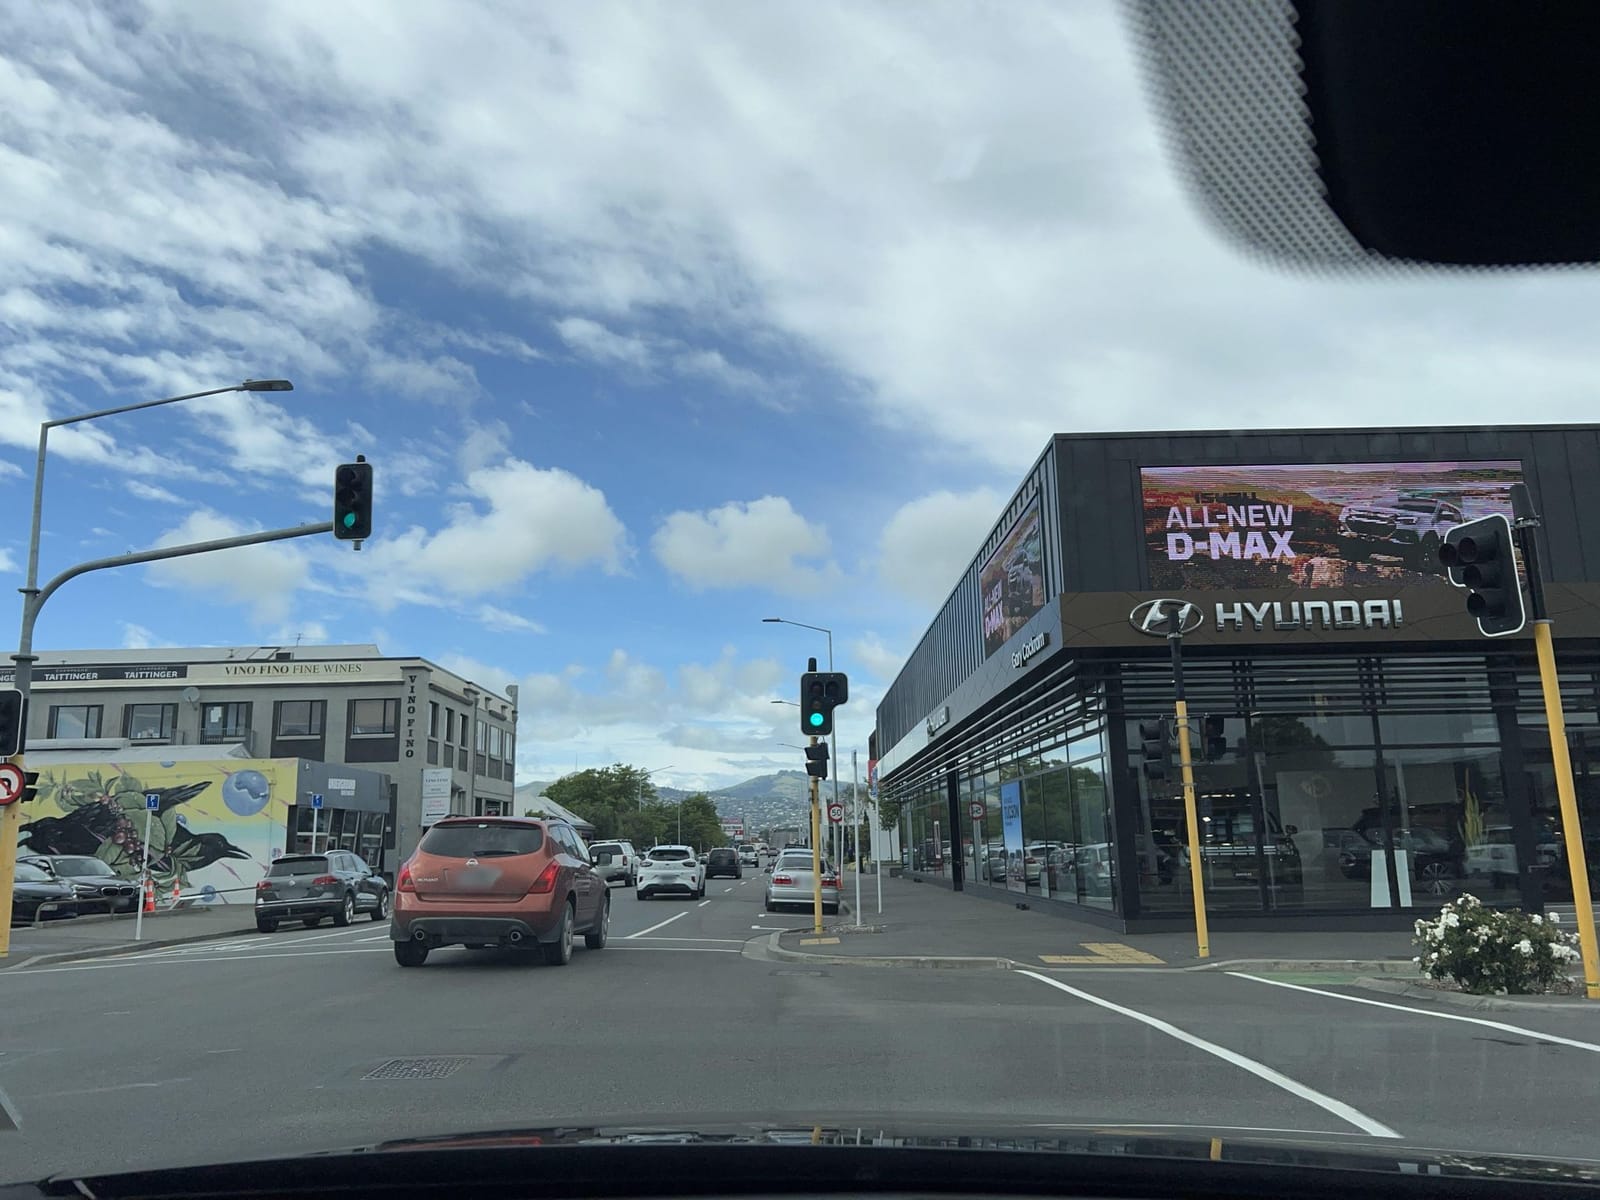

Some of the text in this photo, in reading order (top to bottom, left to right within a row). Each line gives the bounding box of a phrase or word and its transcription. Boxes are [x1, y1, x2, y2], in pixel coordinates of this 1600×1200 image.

[1166, 504, 1293, 528] ALL-NEW
[1166, 531, 1297, 561] D-MAX
[1215, 600, 1403, 632] HYUNDAI
[1011, 632, 1045, 669] Gary Cockram
[44, 672, 98, 681] TAITTINGER
[124, 671, 177, 679] TAITTINGER
[225, 663, 362, 675] VINO FINO FINE WINES
[405, 675, 417, 758] VINO FINO
[831, 809, 842, 817] 50
